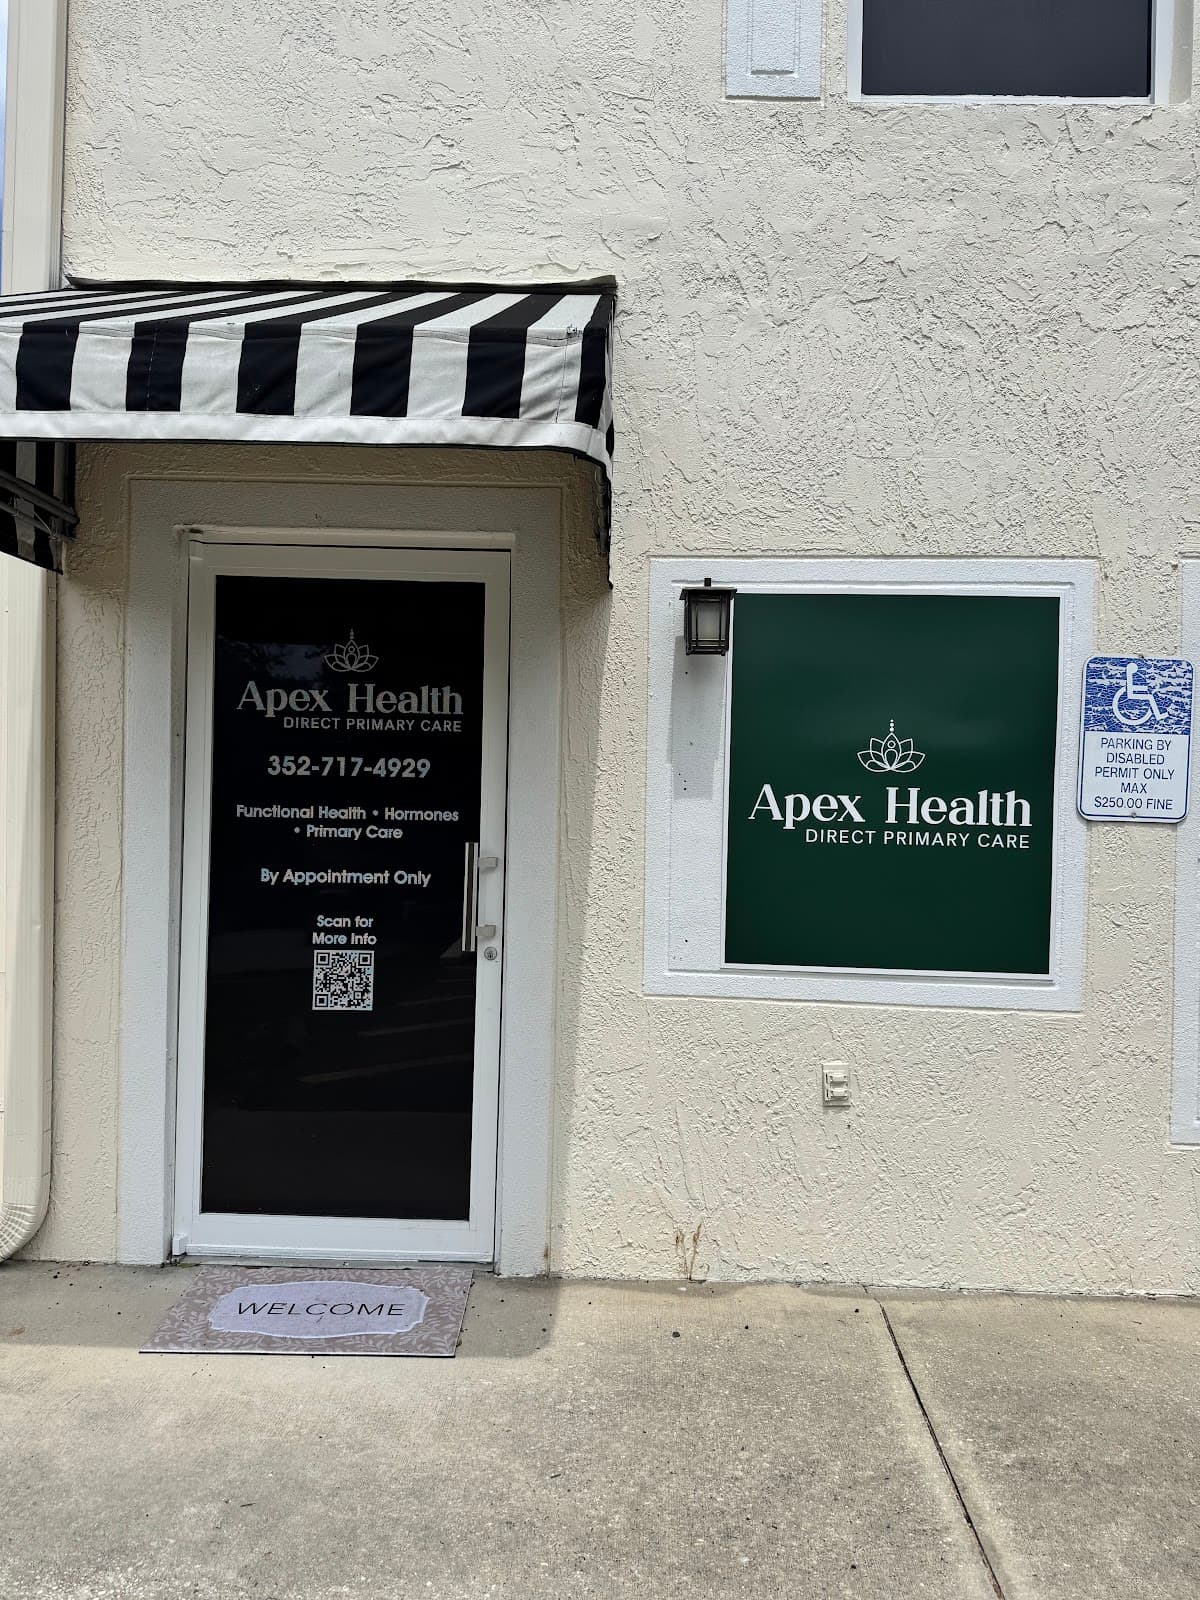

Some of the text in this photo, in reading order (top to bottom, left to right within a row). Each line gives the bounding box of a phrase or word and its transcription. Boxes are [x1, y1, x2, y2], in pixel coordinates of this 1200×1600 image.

[236, 681, 464, 718] Apex Health
[283, 716, 462, 732] DIRECT PRIMARY CARE
[1100, 737, 1172, 751] PARKING BY
[267, 755, 431, 778] 352-717-4929
[1106, 753, 1165, 765] DISABLED
[1095, 767, 1175, 780] PERMIT ONLY
[1120, 783, 1148, 794] MAX
[748, 784, 1032, 830] Apex Health
[1094, 796, 1173, 810] $250.00 FINE
[236, 804, 459, 822] Functional Health Hormones
[306, 824, 403, 840] Primary Care
[805, 829, 1030, 849] DIRECT PRIMARY CARE
[260, 868, 431, 888] By Appointment Only
[316, 915, 374, 928] Scan for
[312, 932, 377, 945] More Info
[237, 1302, 406, 1317] WELCOME
